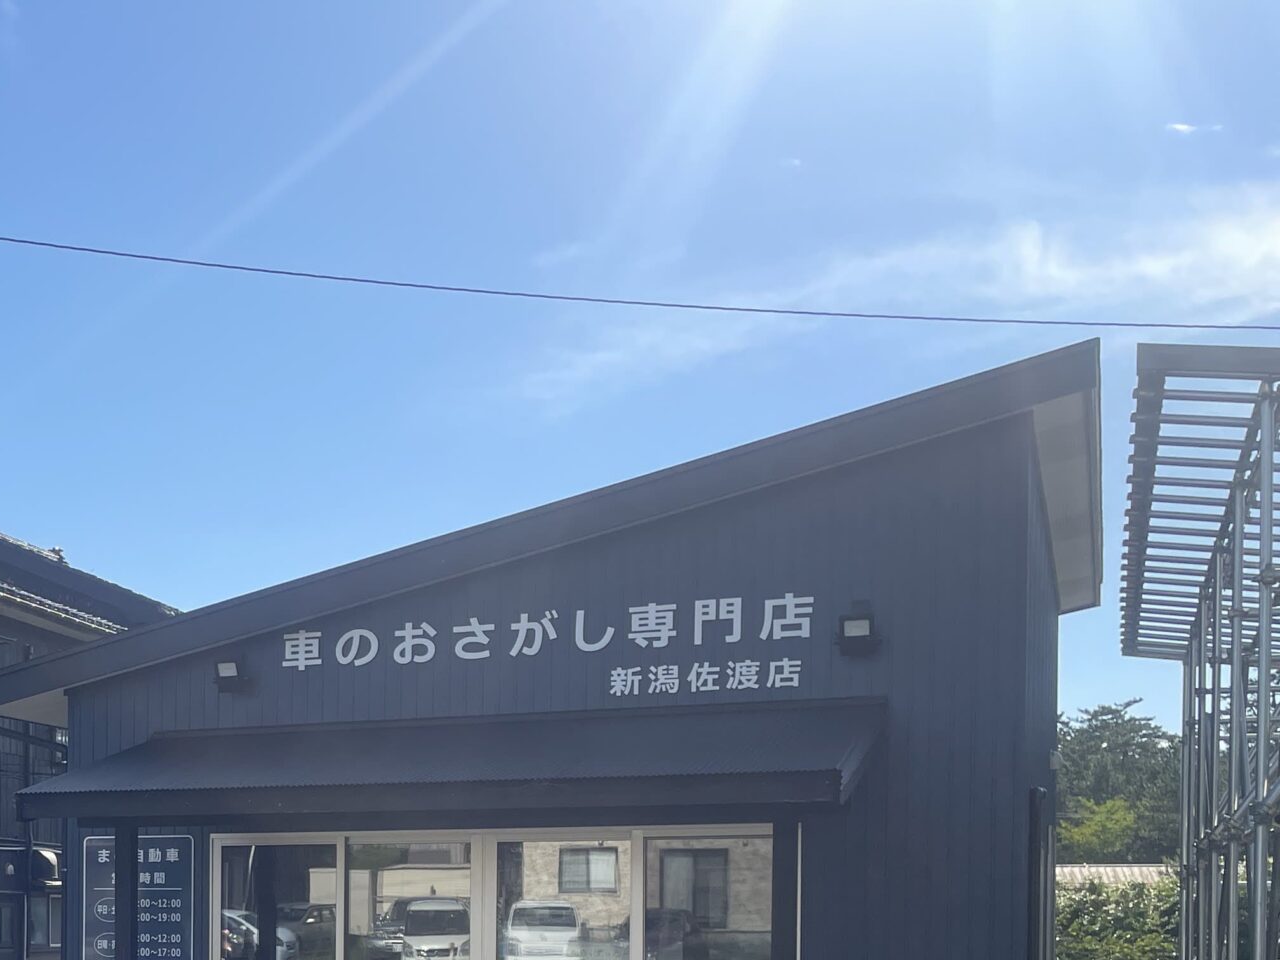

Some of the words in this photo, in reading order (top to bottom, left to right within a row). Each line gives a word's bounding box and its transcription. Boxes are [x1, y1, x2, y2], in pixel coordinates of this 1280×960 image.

[282, 593, 815, 672] 車のおさがし専門店
[609, 658, 802, 696] 新潟佐渡店
[97, 848, 180, 863] ま動車
